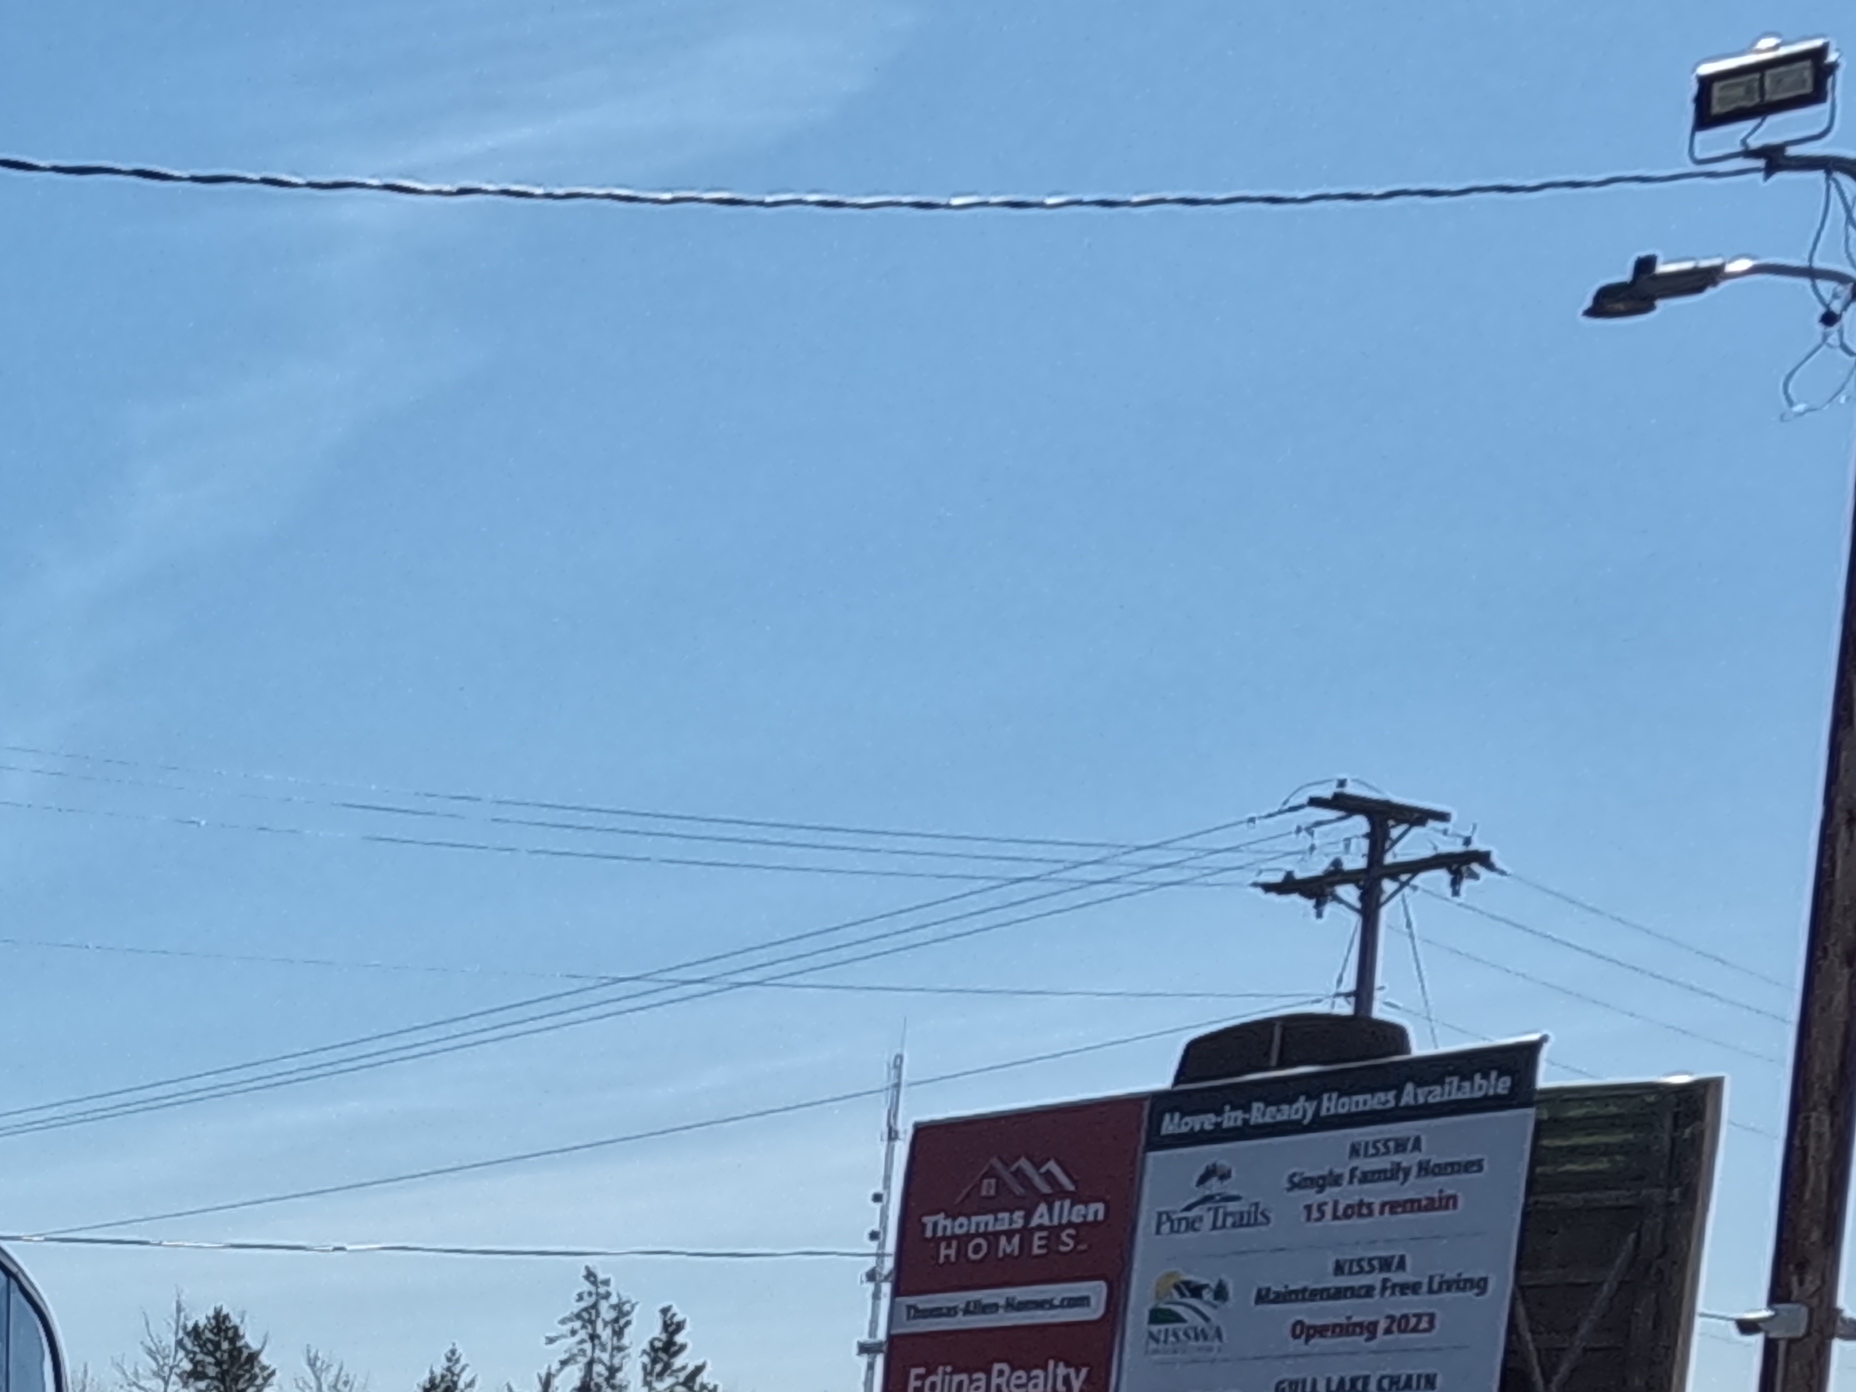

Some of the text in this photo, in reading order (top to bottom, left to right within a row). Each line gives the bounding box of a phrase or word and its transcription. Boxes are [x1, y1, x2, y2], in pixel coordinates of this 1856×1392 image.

[1161, 1070, 1512, 1135] Move-in-Ready Homes Available
[1348, 1135, 1422, 1160] NISSWA
[1286, 1157, 1484, 1194] Single Family Homes
[921, 1198, 1106, 1239] Thomas Allen
[1155, 1202, 1273, 1236] Pine Trails
[1303, 1190, 1457, 1223] 15 Lots remain
[937, 1228, 1078, 1264] HOMES
[1333, 1254, 1407, 1277] NISSWA
[1254, 1273, 1489, 1305] Maintenance Free Living
[1291, 1312, 1436, 1345] Opening 2023
[1376, 1372, 1438, 1392] CHAIN
